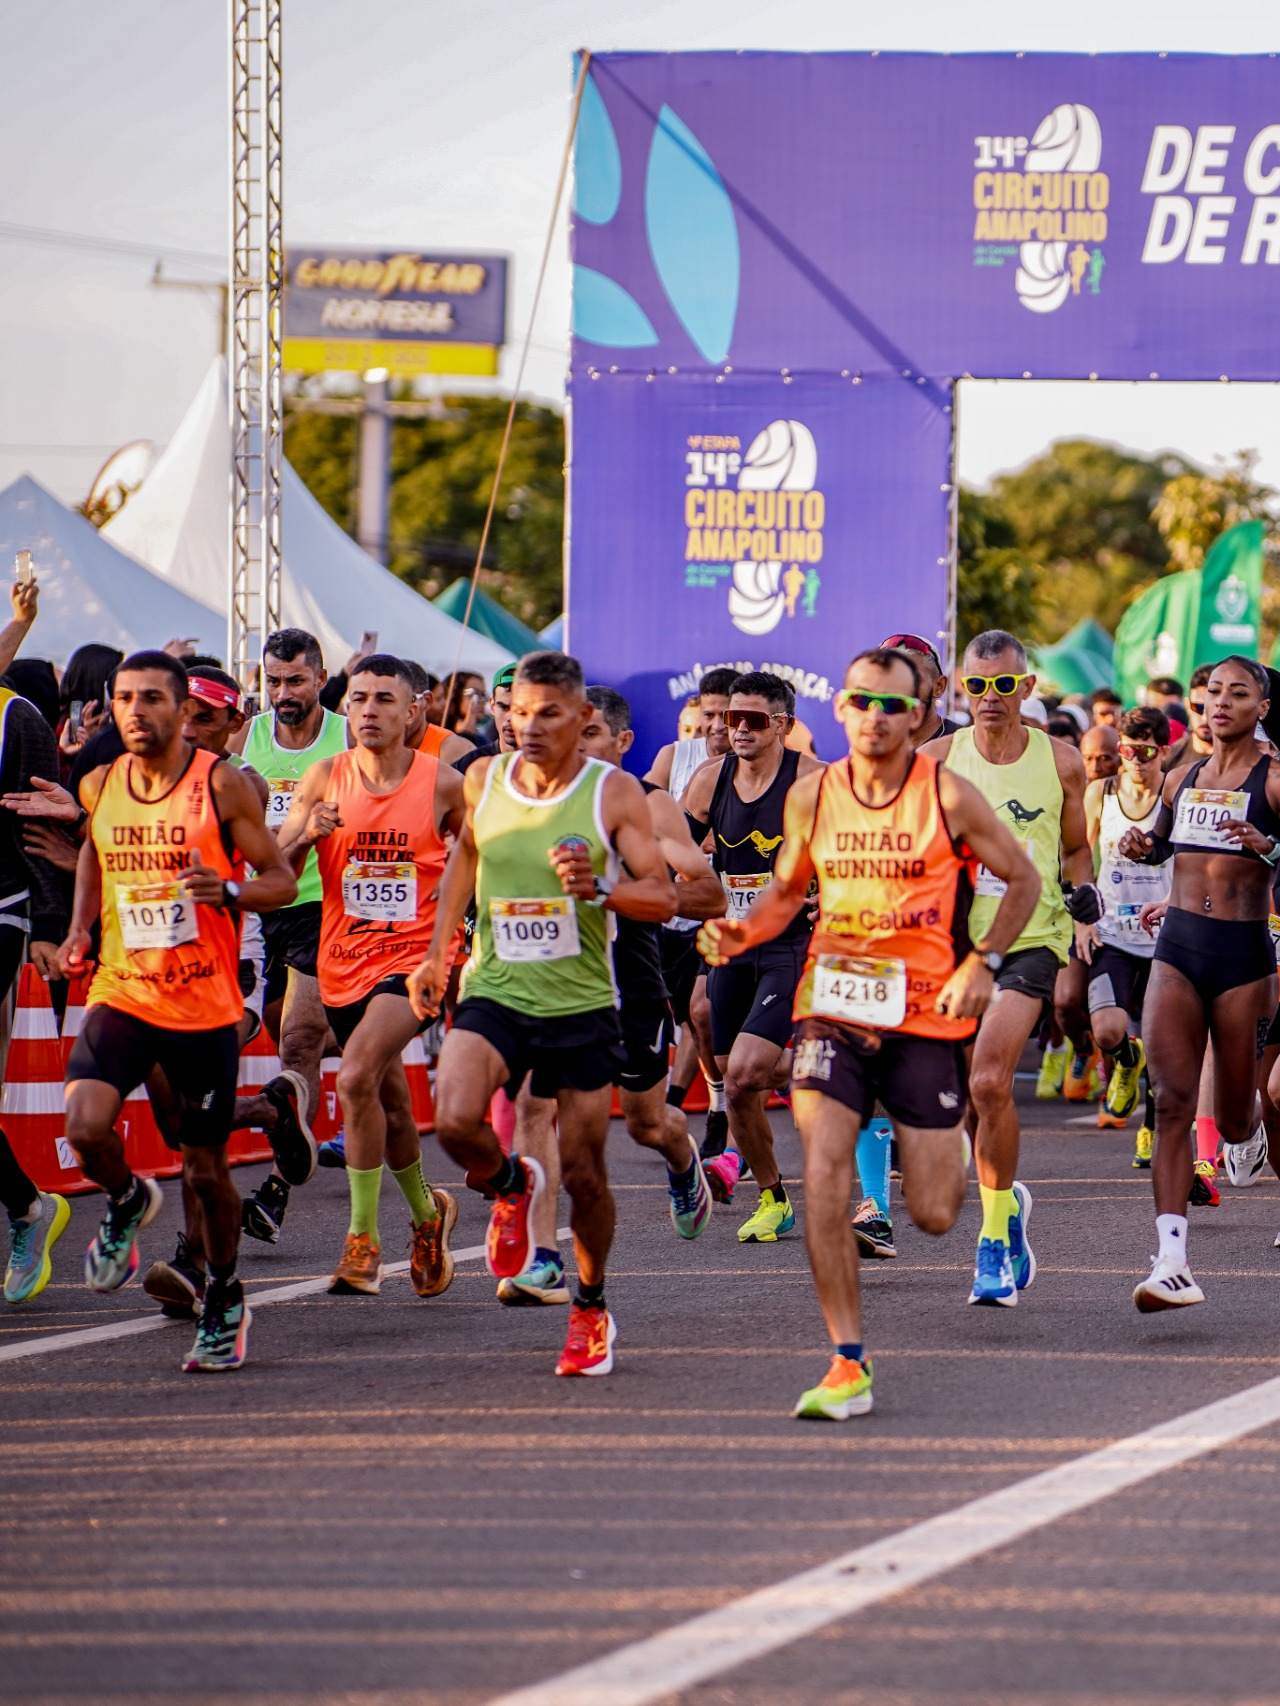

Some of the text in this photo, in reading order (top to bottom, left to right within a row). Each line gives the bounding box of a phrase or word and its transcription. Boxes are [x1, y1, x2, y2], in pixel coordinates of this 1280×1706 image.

[1140, 125, 1237, 194] DE
[973, 172, 1110, 211] CIRCUITO
[973, 210, 1108, 242] ANAPOLINO
[1140, 196, 1237, 264] DE
[685, 452, 741, 486] 14º
[685, 488, 825, 531] CIRCUITO
[685, 528, 823, 563] ANAPOLINO
[1188, 807, 1231, 825] 1010
[112, 820, 186, 846] UNIÃO
[357, 828, 409, 846] UNIÃO
[837, 826, 911, 851] UNIÃO
[825, 860, 925, 878] RUNNING
[352, 883, 408, 902] 1355
[730, 891, 762, 907] 176
[128, 904, 186, 926] 1012
[502, 921, 559, 940] 1009
[830, 980, 887, 1002] 4218
